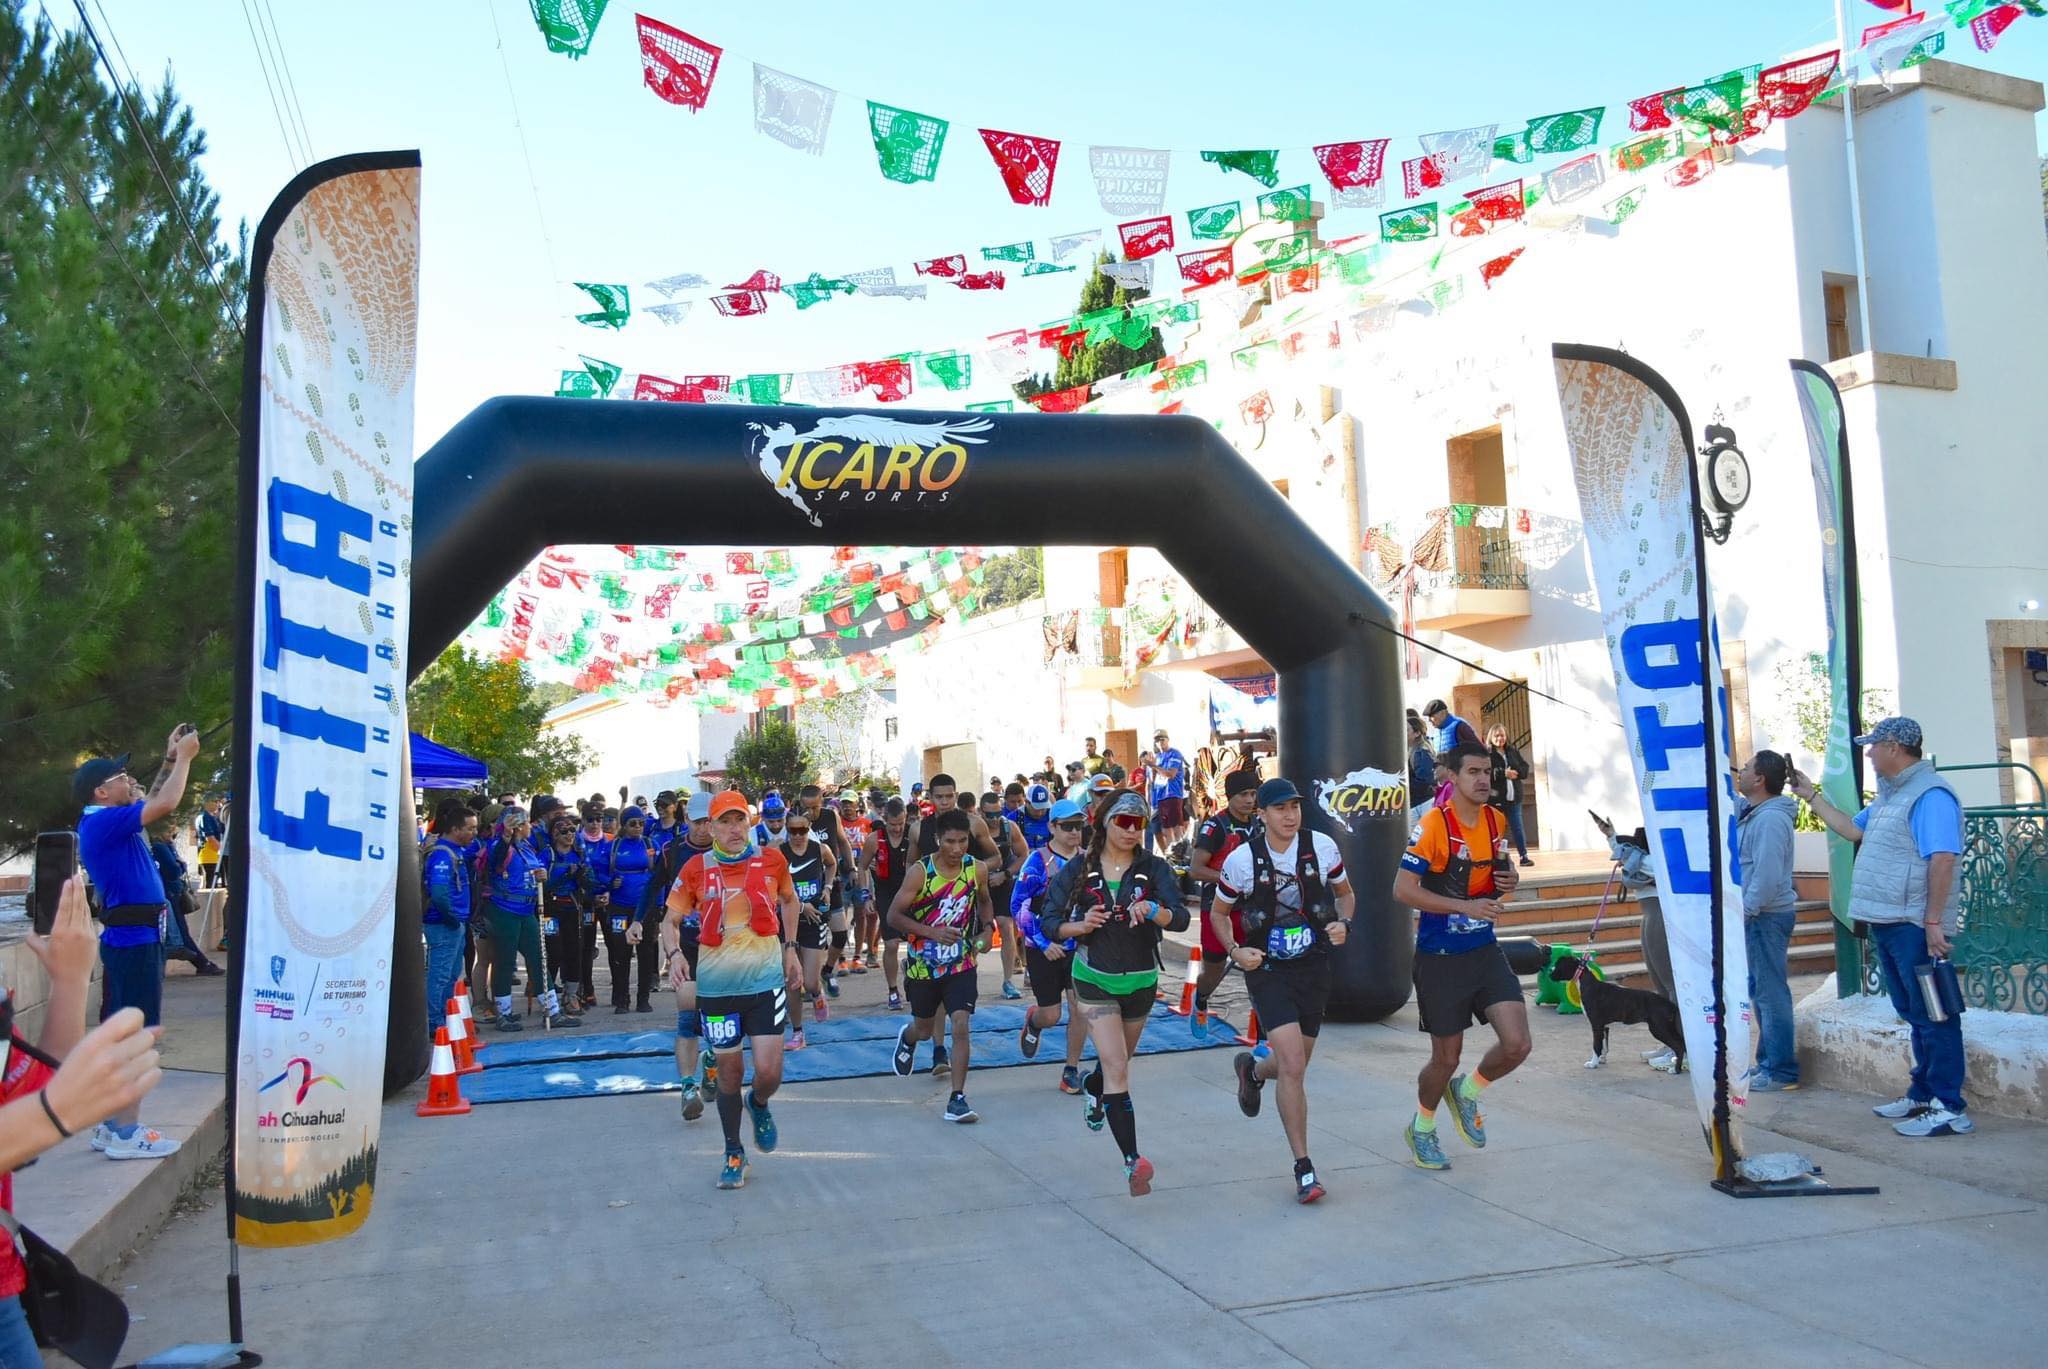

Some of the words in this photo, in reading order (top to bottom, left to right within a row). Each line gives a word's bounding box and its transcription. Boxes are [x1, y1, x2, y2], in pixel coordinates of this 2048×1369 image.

[776, 441, 968, 490] ICARO
[815, 491, 949, 503] SPORTS
[257, 477, 372, 861] FITA
[367, 520, 398, 860] CHIHUAHUA
[1328, 785, 1405, 812] ICARO
[797, 883, 817, 897] 156
[1284, 928, 1312, 950] 128
[935, 942, 959, 959] 120
[323, 992, 335, 1000] DE
[336, 991, 367, 999] TURISMO
[706, 1020, 736, 1039] 186
